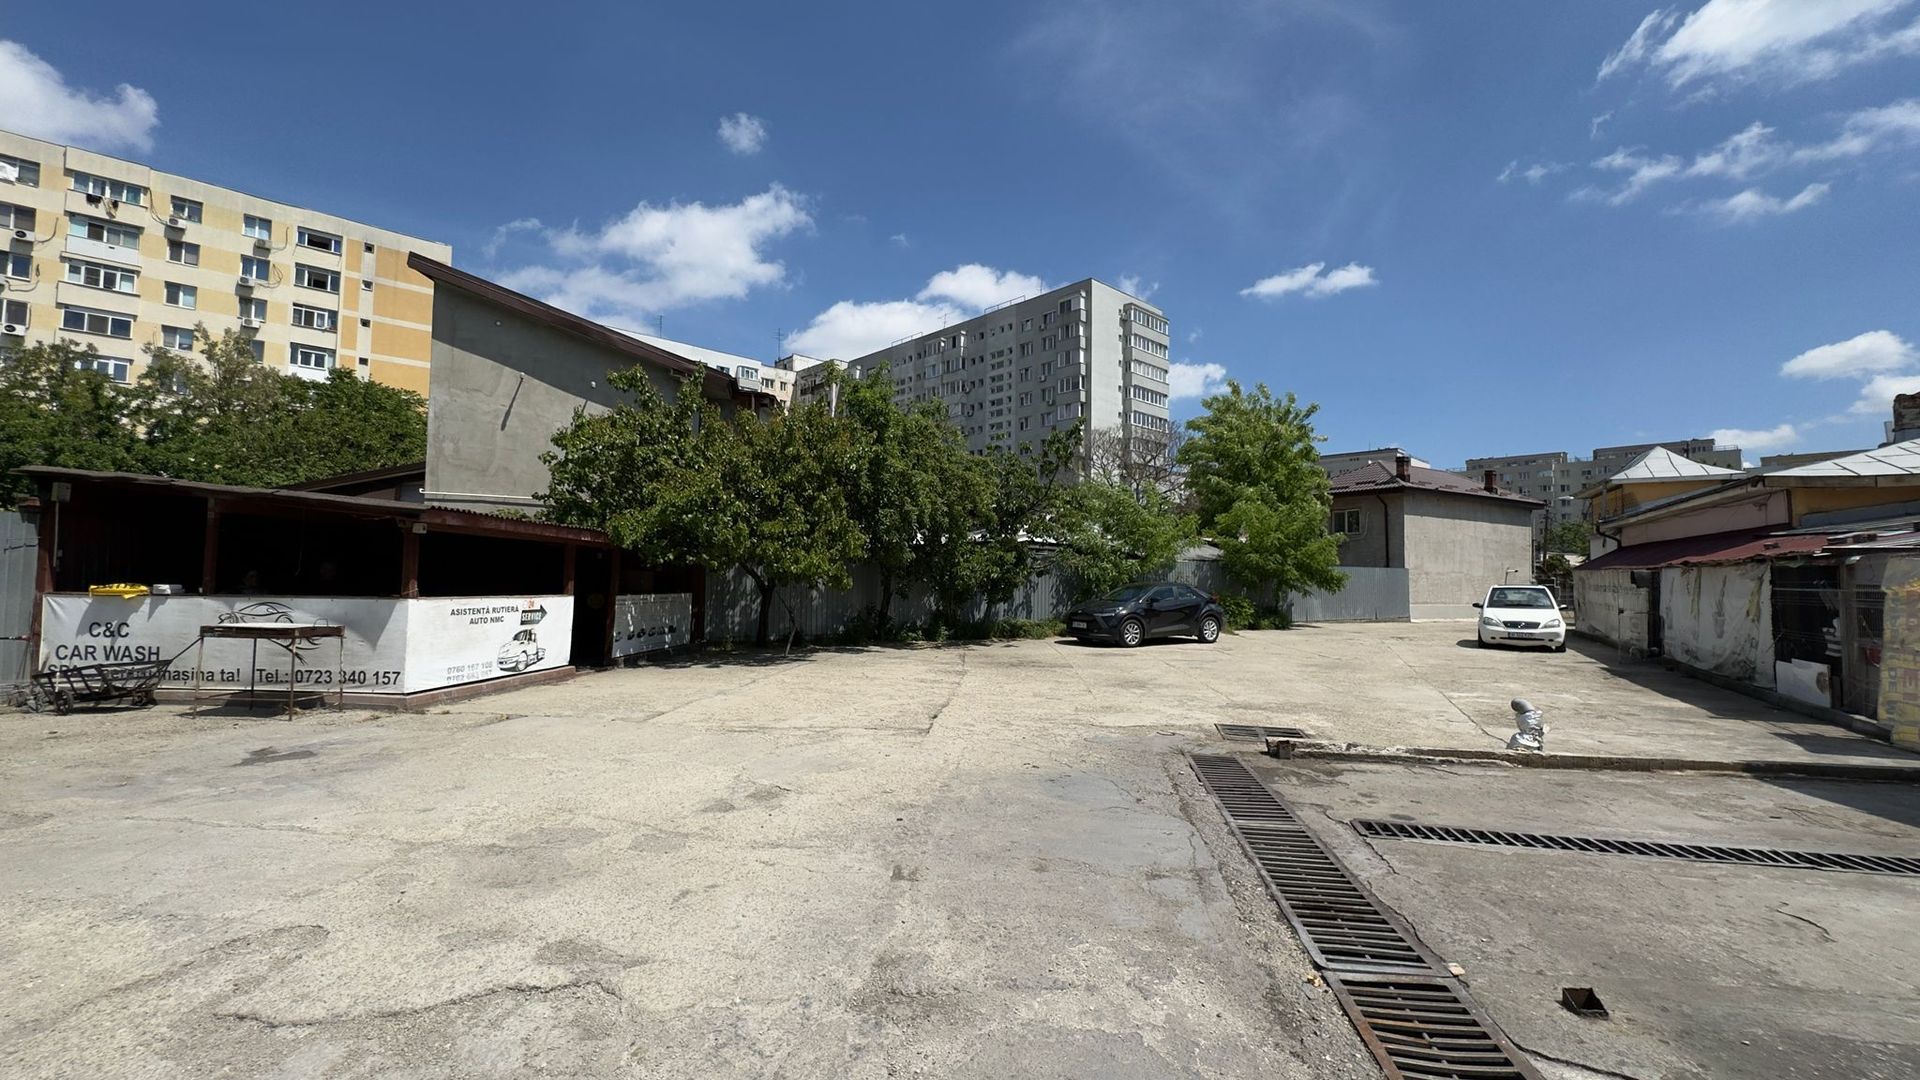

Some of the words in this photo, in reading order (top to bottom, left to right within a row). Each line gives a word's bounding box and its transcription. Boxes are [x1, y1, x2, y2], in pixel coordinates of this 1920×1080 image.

[469, 617, 488, 625] AUTO
[489, 616, 505, 624] NMC
[88, 621, 131, 639] C&C
[55, 644, 98, 661] CAR
[103, 645, 160, 662] WASH
[220, 668, 241, 682] ta!
[294, 669, 333, 684] 0723
[338, 670, 367, 685] 340
[372, 671, 401, 686] 157
